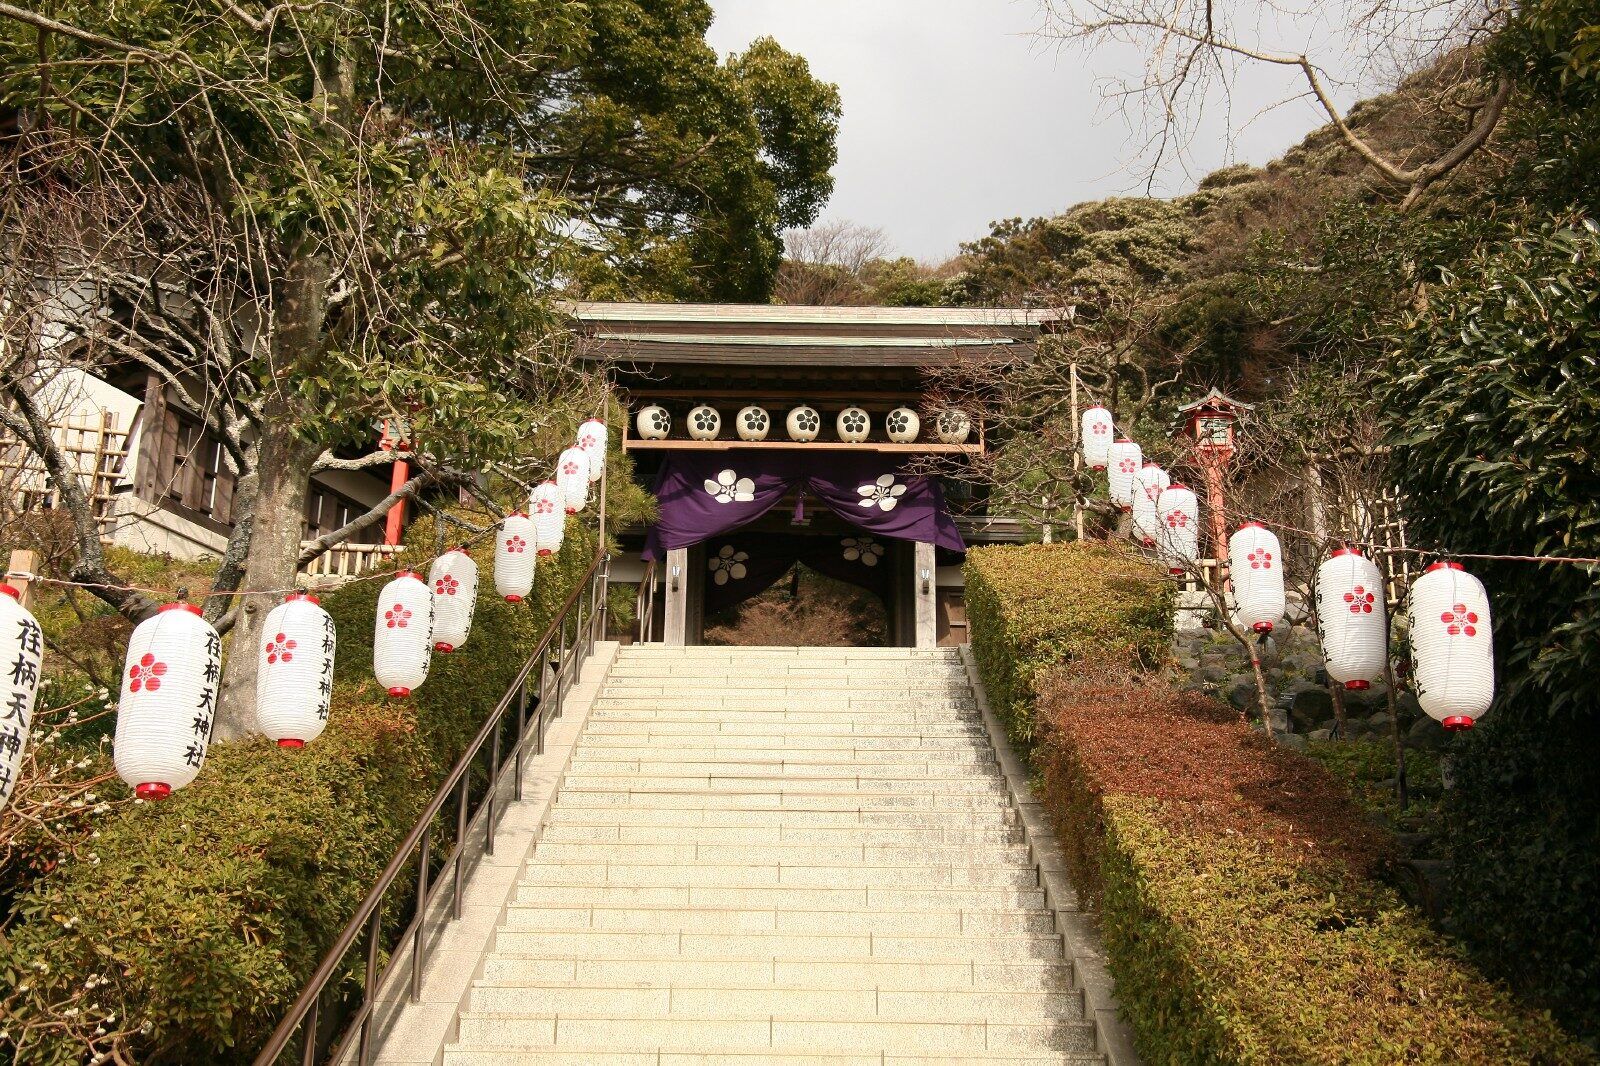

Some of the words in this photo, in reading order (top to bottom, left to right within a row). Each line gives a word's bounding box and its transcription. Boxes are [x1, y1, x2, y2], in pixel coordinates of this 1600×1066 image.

[183, 631, 221, 769] 荏柄天神社
